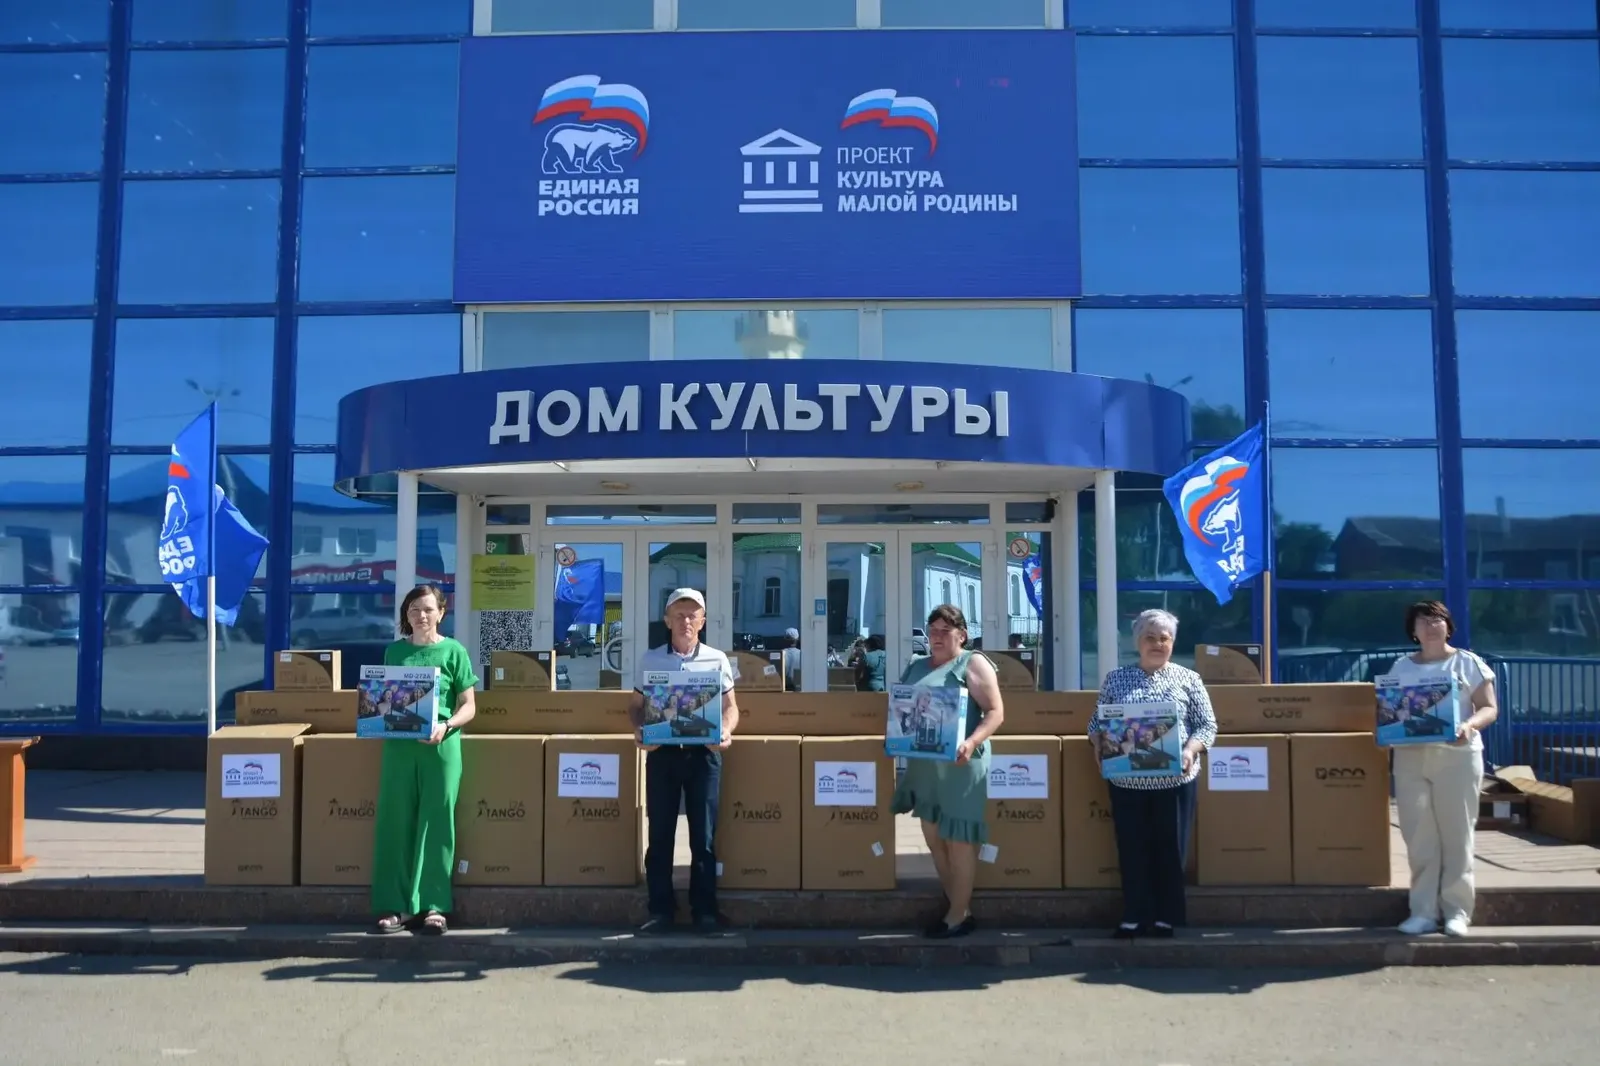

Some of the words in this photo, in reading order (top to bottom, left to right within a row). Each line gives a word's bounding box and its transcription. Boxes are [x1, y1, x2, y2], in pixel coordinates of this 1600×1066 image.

[837, 147, 913, 164] ПРОЕКТ
[837, 171, 944, 189] КУЛЬТУРА
[538, 178, 640, 198] ЕДИНАЯ
[837, 190, 918, 212] МАЛОЙ
[923, 194, 1018, 213] РОДИНЫ
[537, 198, 639, 216] РОССИЯ
[489, 384, 641, 445] ДОМ
[658, 381, 1010, 437] КУЛЬТУРЫ
[240, 807, 278, 817] TANGO
[338, 807, 375, 817] TANGO
[486, 808, 526, 818] TANGO
[581, 808, 621, 818] TANGO
[742, 810, 782, 820] TANGO
[840, 811, 879, 821] TANGO
[1005, 810, 1046, 820] TANGO
